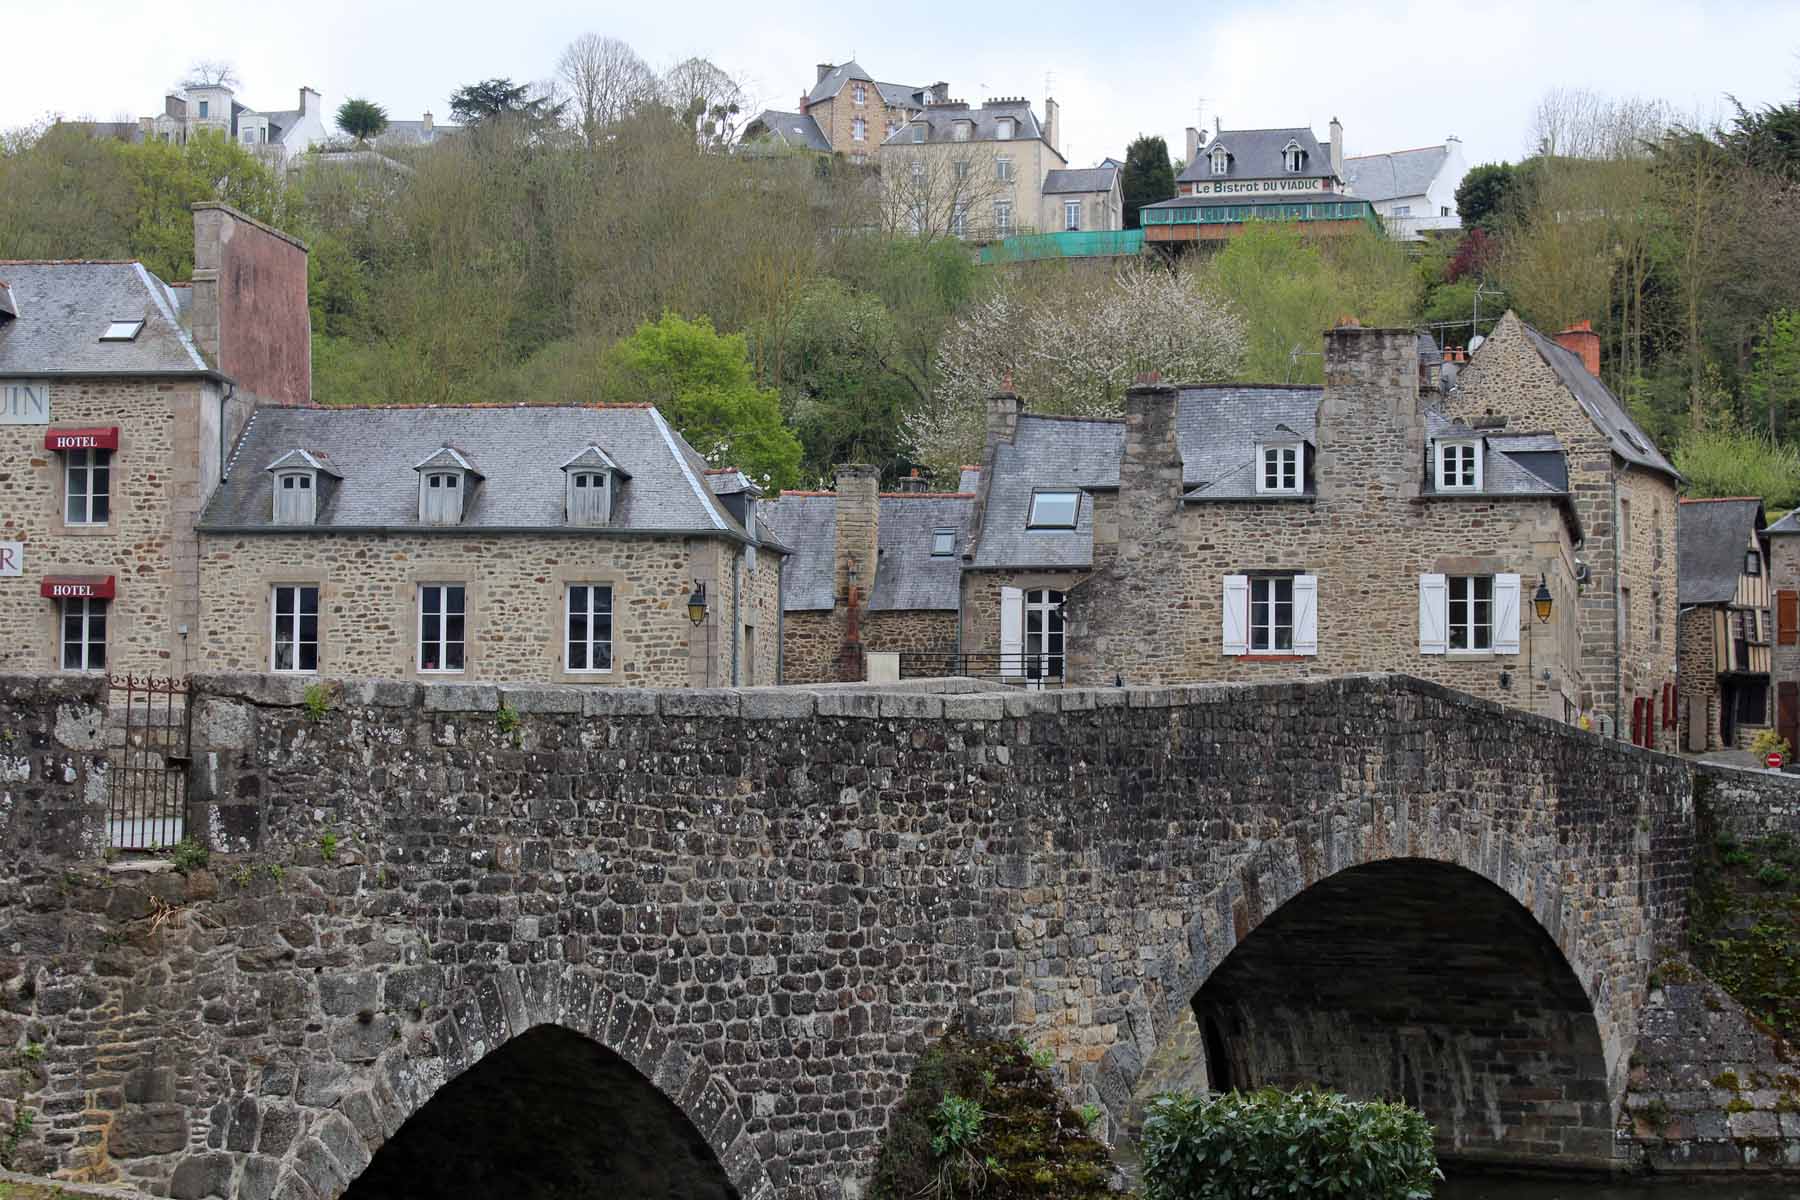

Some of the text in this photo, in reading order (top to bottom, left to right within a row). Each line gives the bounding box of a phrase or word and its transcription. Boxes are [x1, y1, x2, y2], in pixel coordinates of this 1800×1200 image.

[1196, 180, 1319, 193] Le Bistrot DU VIADUC
[57, 436, 98, 448] HOTEL
[53, 585, 94, 596] HOTEL
